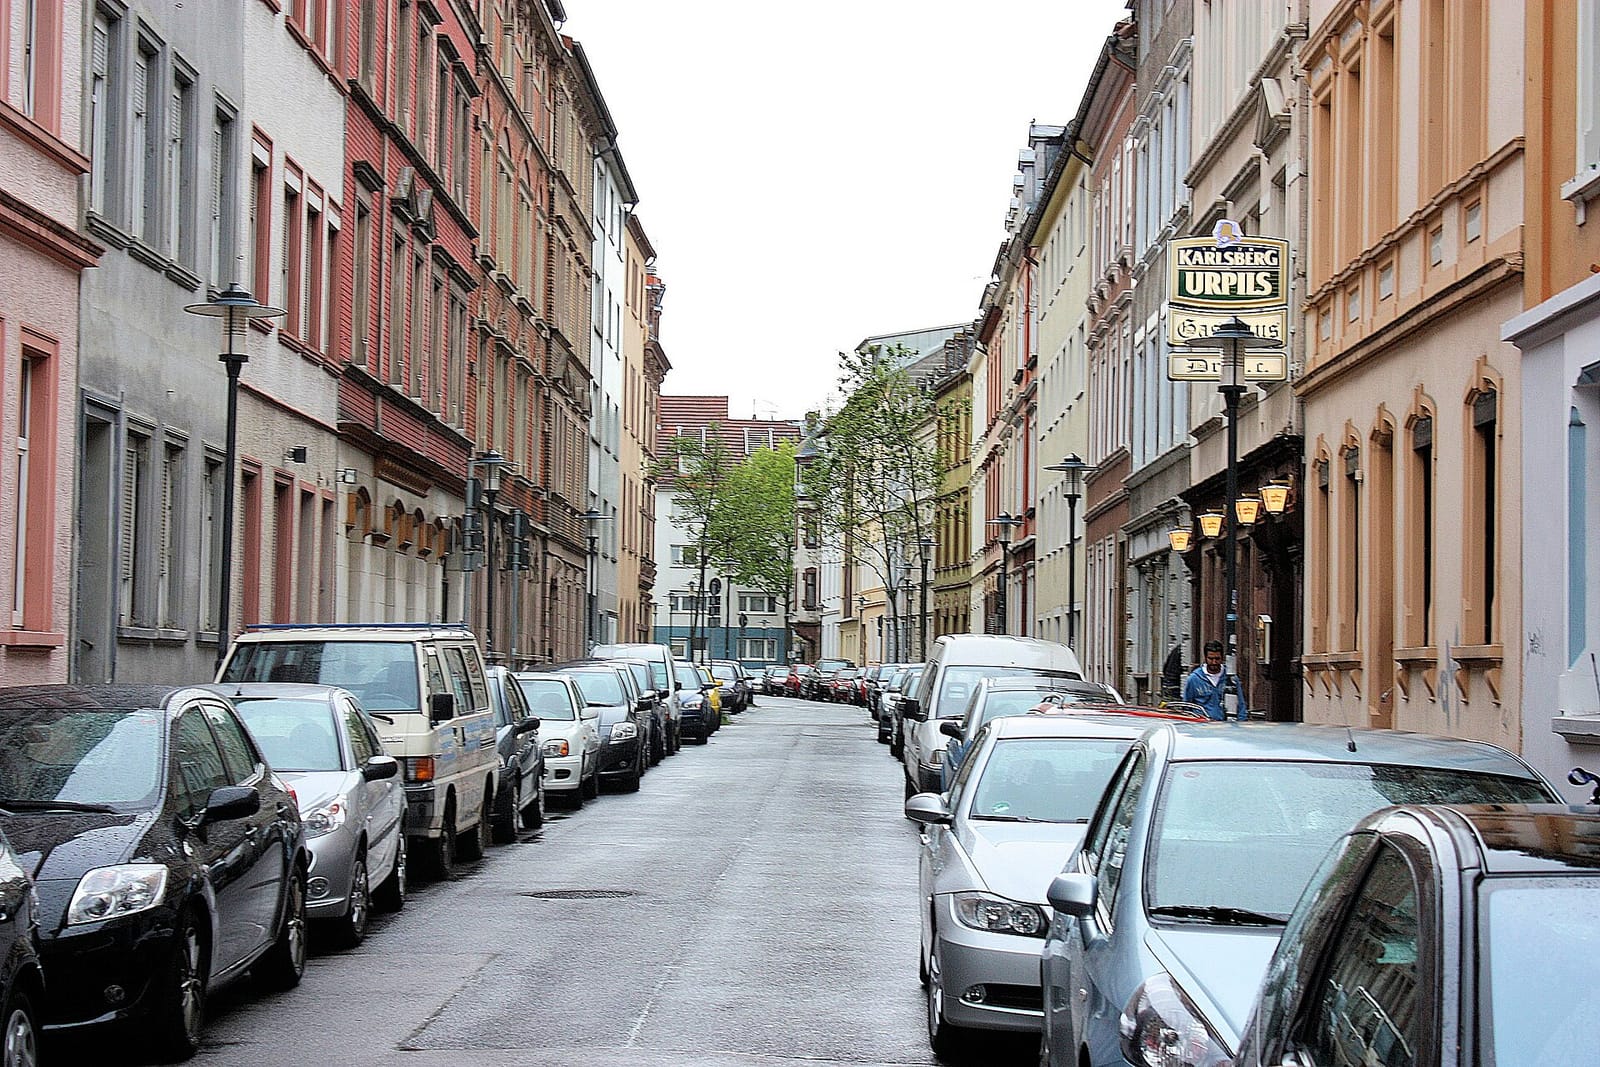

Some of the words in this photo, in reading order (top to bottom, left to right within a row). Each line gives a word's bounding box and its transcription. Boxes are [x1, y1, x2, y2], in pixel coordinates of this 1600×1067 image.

[1178, 248, 1279, 266] KARLSBERG
[1185, 271, 1273, 296] URPILS
[1177, 319, 1280, 338] Gasus
